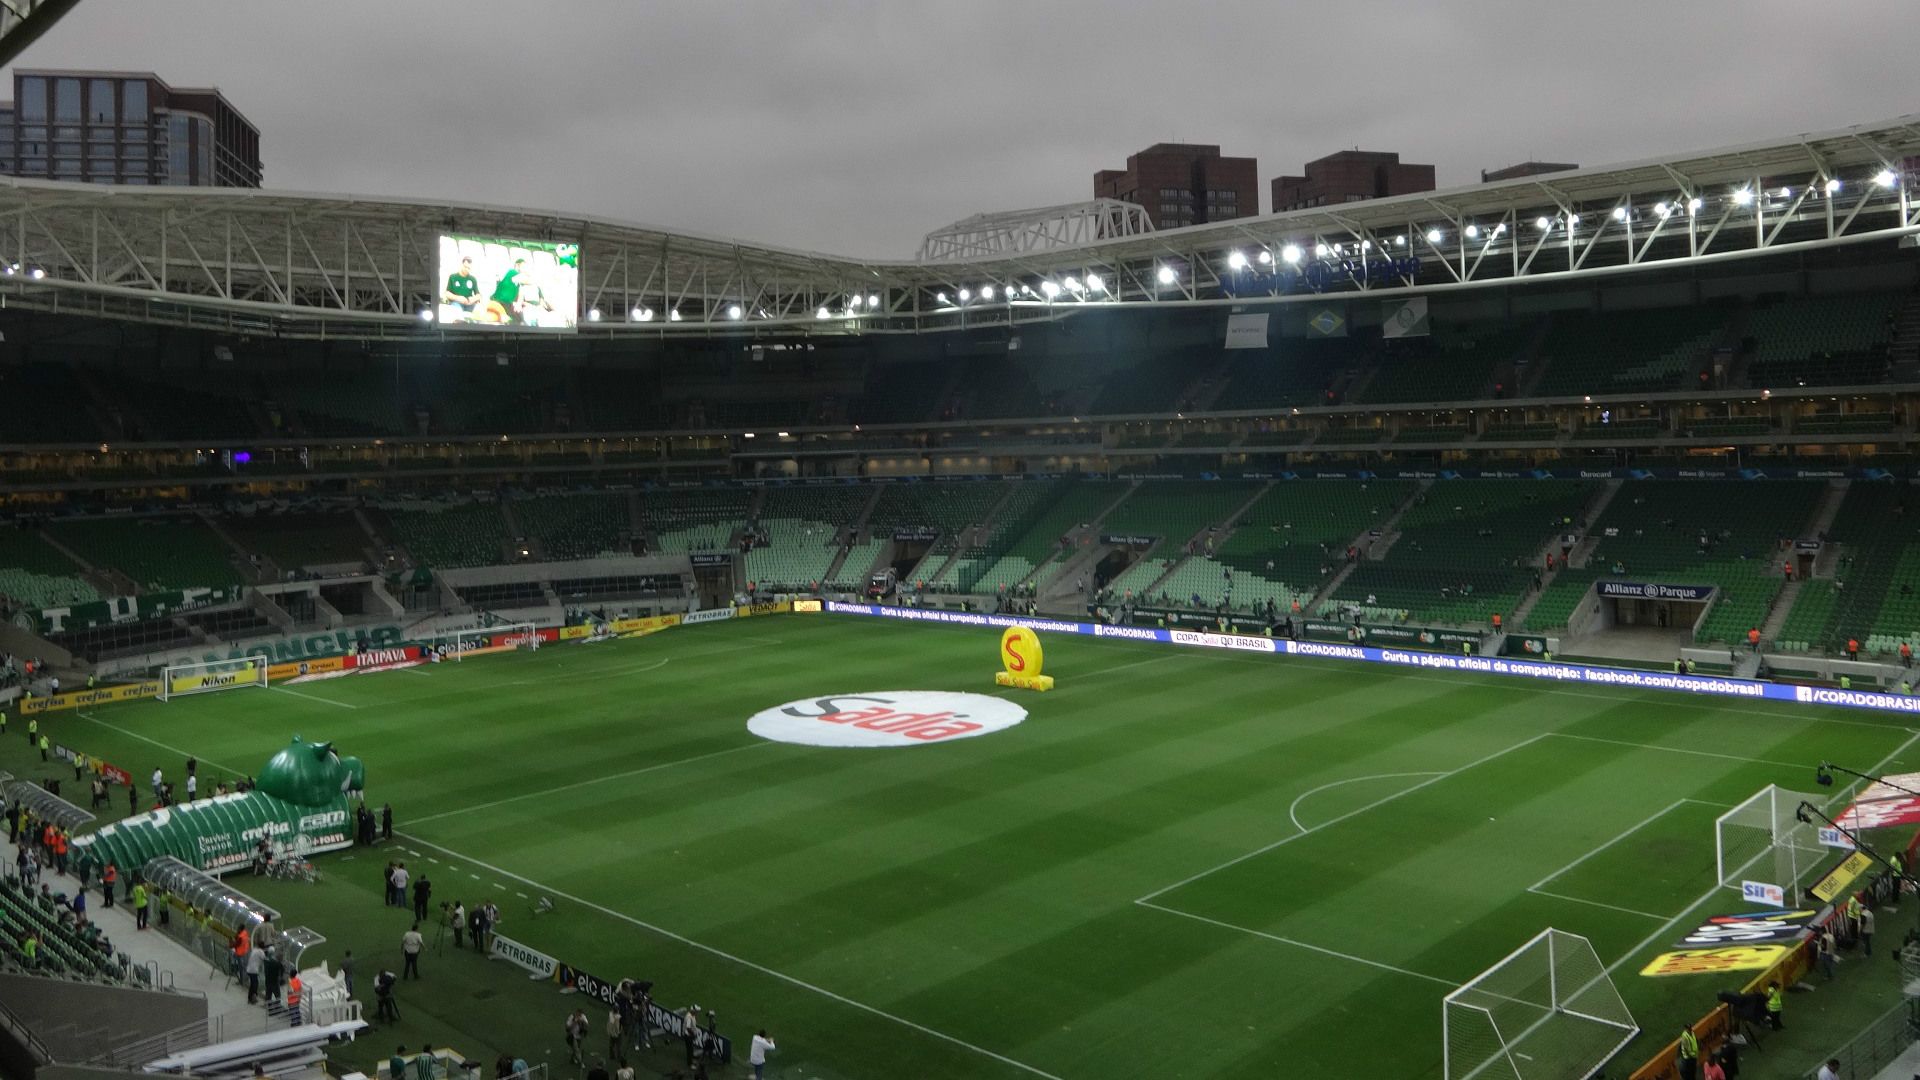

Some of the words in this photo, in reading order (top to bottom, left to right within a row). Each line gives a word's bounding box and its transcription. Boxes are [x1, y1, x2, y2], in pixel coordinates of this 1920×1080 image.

[1604, 583, 1642, 595] Allianz
[1659, 585, 1696, 599] Parque
[688, 609, 731, 621] PETROBRAS
[1176, 632, 1199, 643] COPA
[1236, 638, 1268, 649] BRASIL
[356, 648, 407, 667] ITAIPAVA
[438, 644, 456, 655] elo
[1006, 635, 1024, 672] S
[201, 675, 236, 687] Nikon
[1382, 651, 1410, 663] Curta
[1421, 655, 1456, 669] página
[1458, 659, 1491, 670] oficial
[1493, 661, 1508, 672] da
[1511, 664, 1581, 679] competição:
[1585, 669, 1763, 697] facebook.com/copadobrasil
[781, 697, 984, 740] Sadia
[1819, 830, 1839, 843] Sil
[1744, 884, 1765, 898] Sil
[496, 940, 552, 974] PETROBRAS
